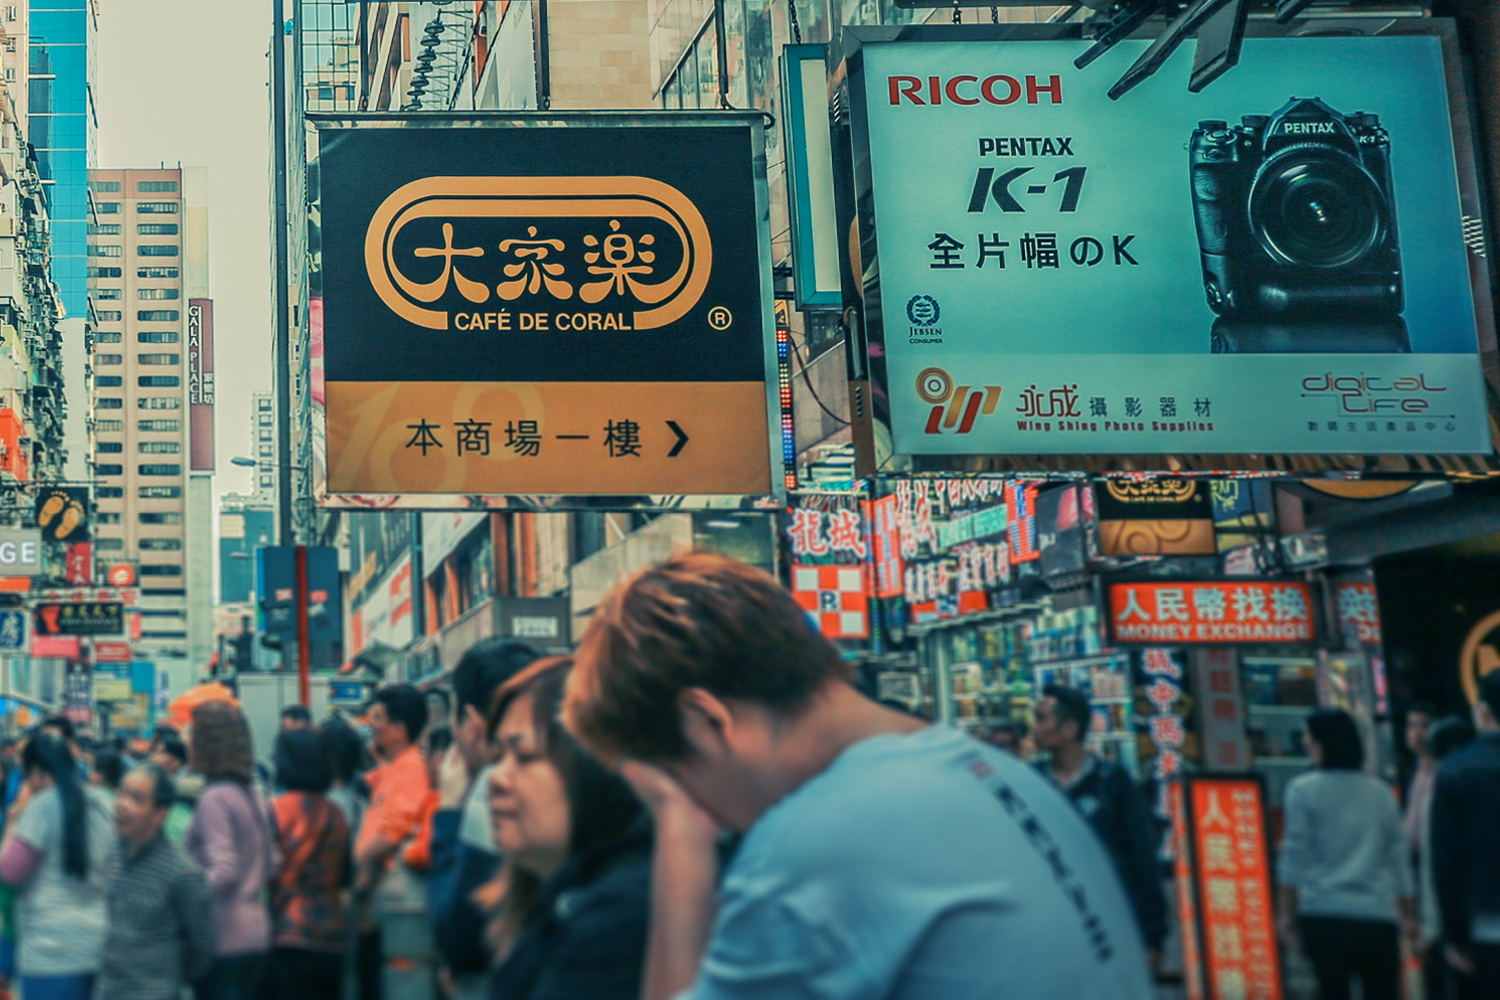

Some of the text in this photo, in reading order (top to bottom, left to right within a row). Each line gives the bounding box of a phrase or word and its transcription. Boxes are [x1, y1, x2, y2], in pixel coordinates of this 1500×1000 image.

[887, 75, 1063, 106] RICOH
[1283, 122, 1335, 134] PENTAX
[978, 136, 1075, 158] PENTAX
[966, 166, 1089, 214] K-1
[926, 231, 1140, 270] 全片幅のK
[189, 305, 199, 347] GALA
[454, 307, 634, 331] CAFÉ DE CORAL
[189, 352, 200, 405] PLACE
[404, 417, 644, 459] 本商場一樓
[1017, 420, 1215, 433] Wing Shing Photo Supplies
[1117, 586, 1309, 623] 人民幣找換
[1117, 623, 1309, 640] MONEY EXCHANGE
